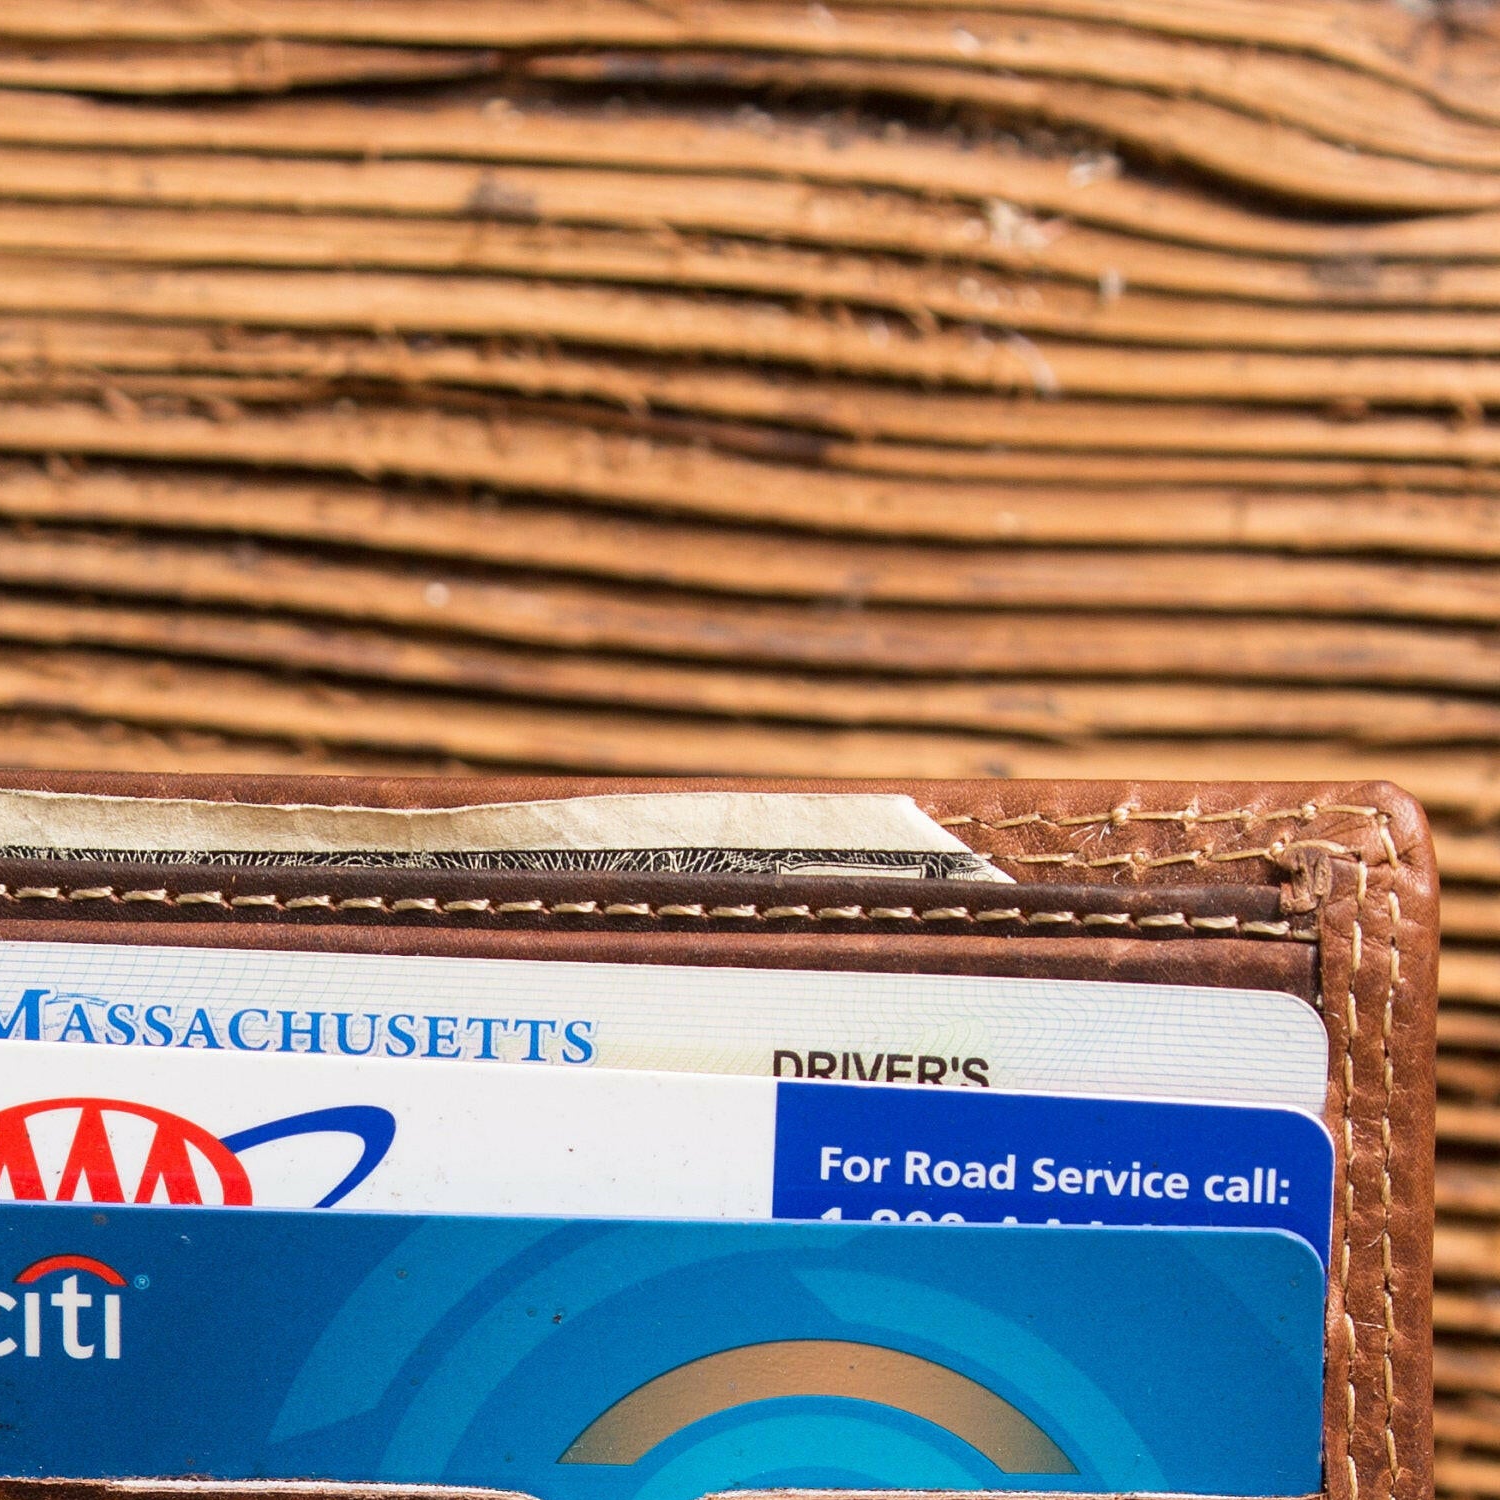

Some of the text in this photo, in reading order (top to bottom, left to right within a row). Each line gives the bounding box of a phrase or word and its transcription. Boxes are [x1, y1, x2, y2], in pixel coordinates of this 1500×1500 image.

[773, 1050, 990, 1087] DRIVER'S
[820, 1146, 1290, 1205] For Road Service call:
